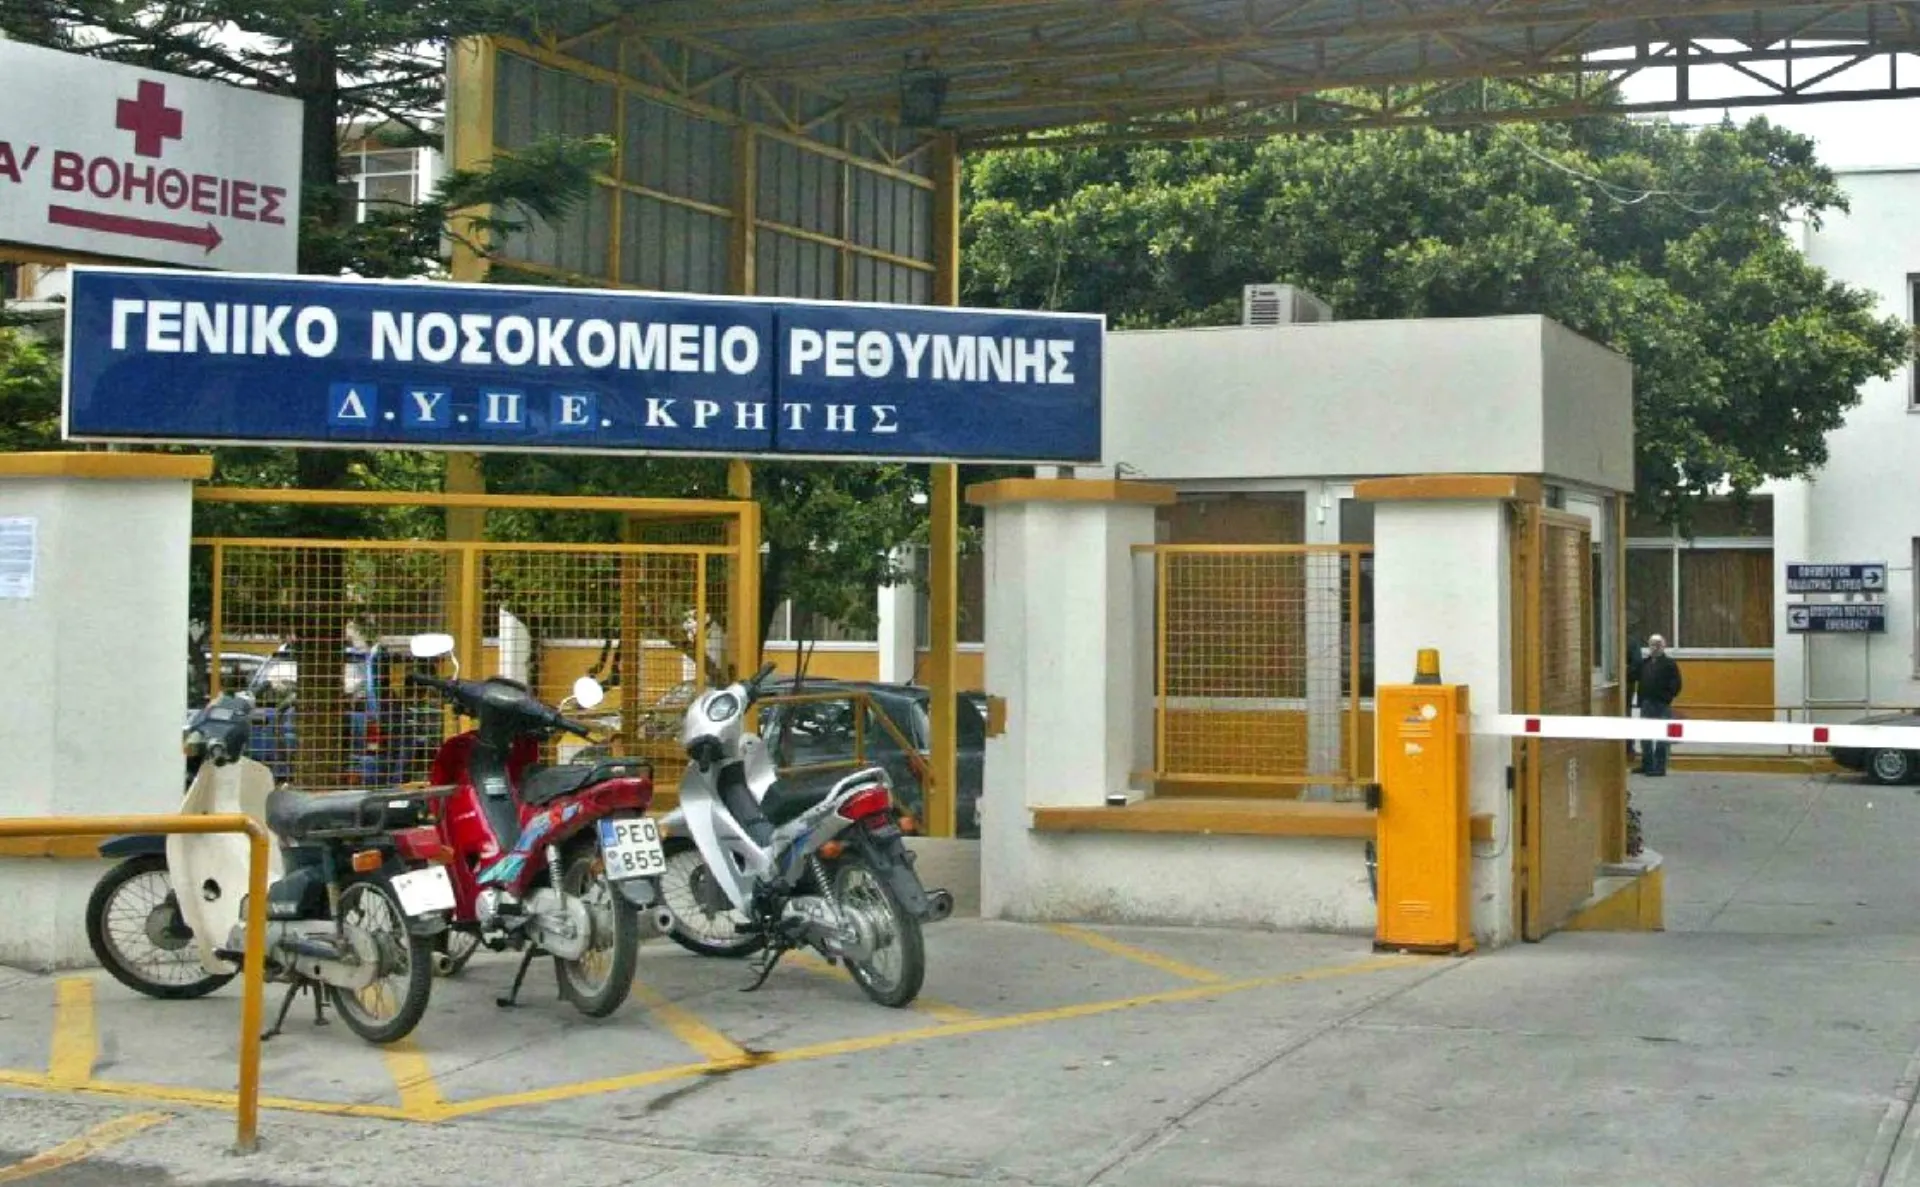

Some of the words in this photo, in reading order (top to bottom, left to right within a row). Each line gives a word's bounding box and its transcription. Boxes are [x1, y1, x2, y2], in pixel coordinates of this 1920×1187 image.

[52, 149, 288, 226] ΒΟΗΘΕΙΕΣ
[110, 299, 339, 358] ΓΕΝΙΚΟ
[370, 311, 760, 375] ΝΟΣΟΚΟΜΕΙΟ
[789, 328, 1075, 384] ΡΕΘΥΜΝΗΣ
[645, 397, 898, 433] ΚΡΗΤΗΣ
[622, 848, 664, 872] 855
